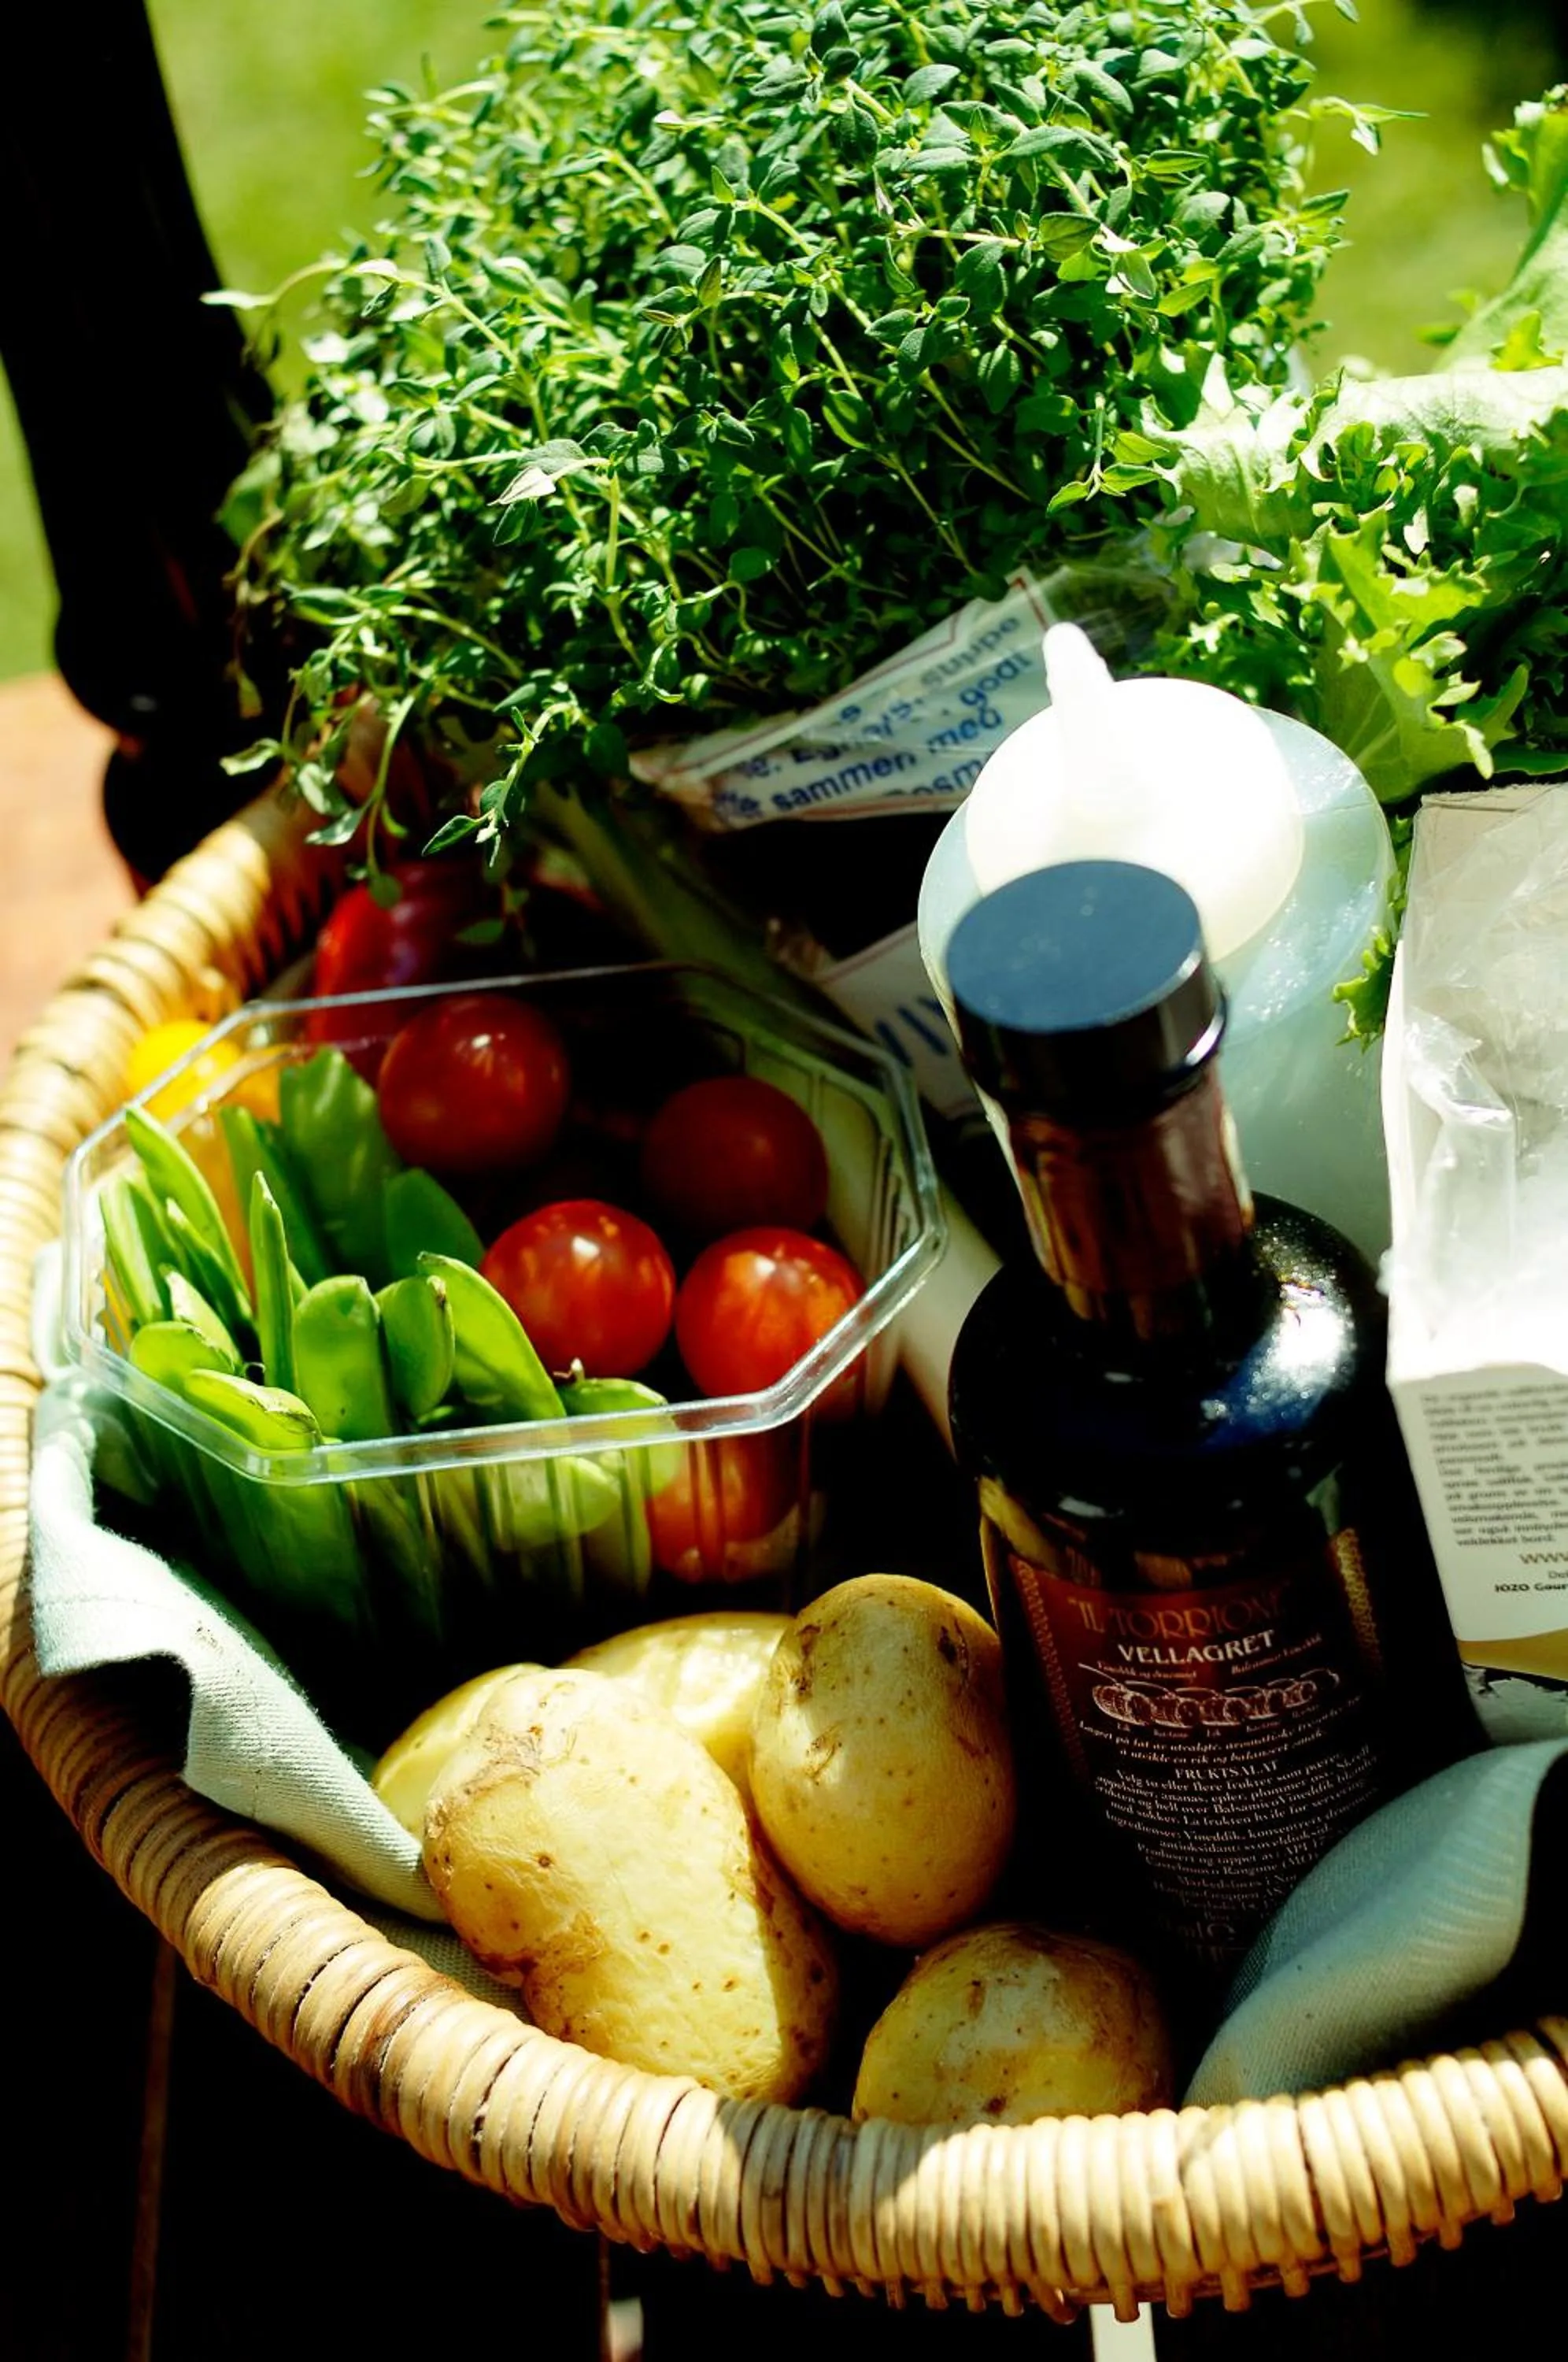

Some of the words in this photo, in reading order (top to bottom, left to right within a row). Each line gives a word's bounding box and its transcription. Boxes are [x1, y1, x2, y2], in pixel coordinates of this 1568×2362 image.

[771, 750, 917, 813] sammen
[926, 707, 1003, 755] med
[1117, 1627, 1275, 1665] VELLAGRET
[1175, 1758, 1278, 1780] FRUKTSALAT
